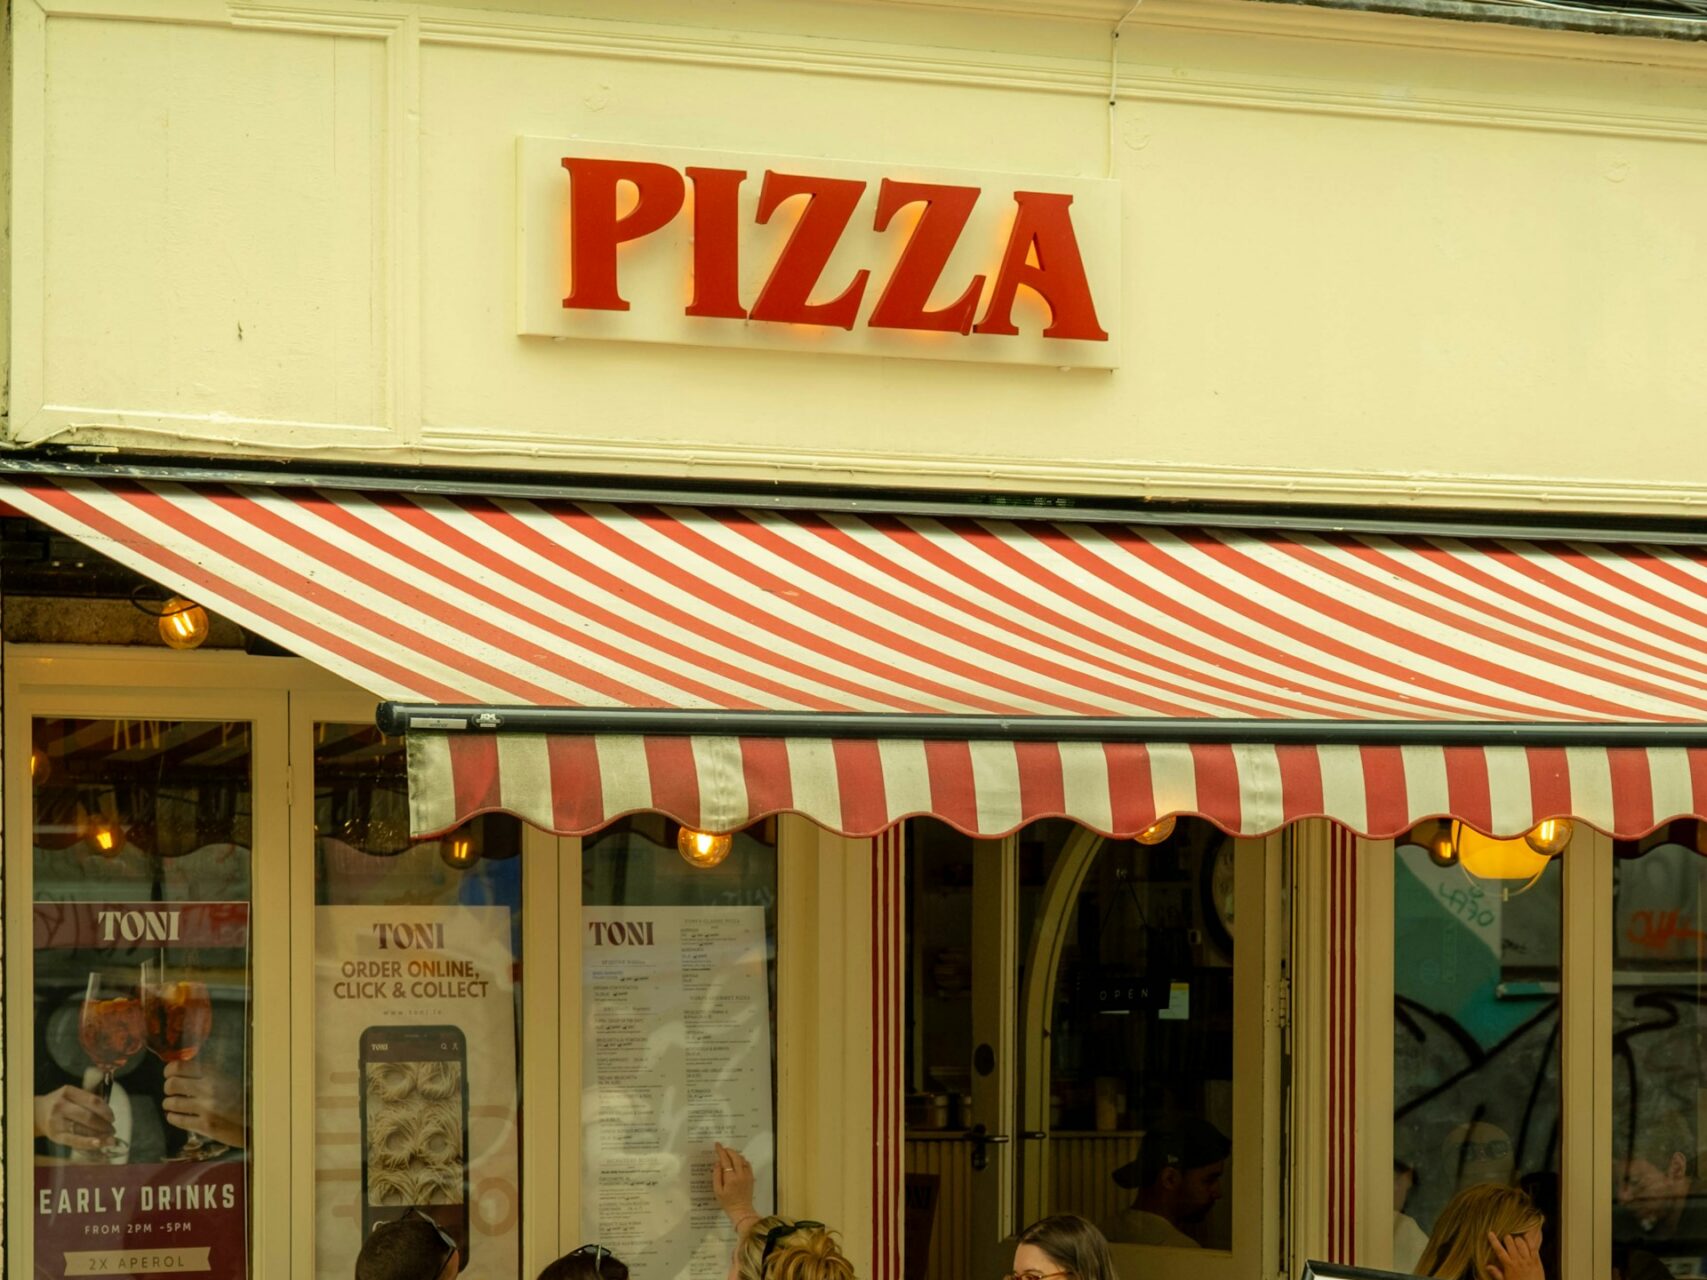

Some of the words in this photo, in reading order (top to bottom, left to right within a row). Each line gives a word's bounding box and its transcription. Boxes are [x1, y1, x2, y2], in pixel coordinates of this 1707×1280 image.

[561, 156, 1109, 342] PIZZA
[98, 910, 180, 941] TONI
[589, 921, 654, 946] TONI
[373, 923, 445, 950] TONI
[341, 961, 402, 979] ORDER
[407, 960, 480, 980] ONLINE,
[333, 982, 387, 999] CLICK
[392, 981, 407, 999] &
[410, 981, 488, 998] COLLECT
[1099, 988, 1149, 1001] OPEN
[371, 1043, 388, 1051] TONI
[39, 1187, 126, 1215] EARLY
[141, 1183, 235, 1211] DRINKS
[84, 1224, 120, 1235] FROM
[127, 1223, 152, 1234] 2PM
[89, 1257, 108, 1271] 2X
[118, 1255, 184, 1269] APEROL
